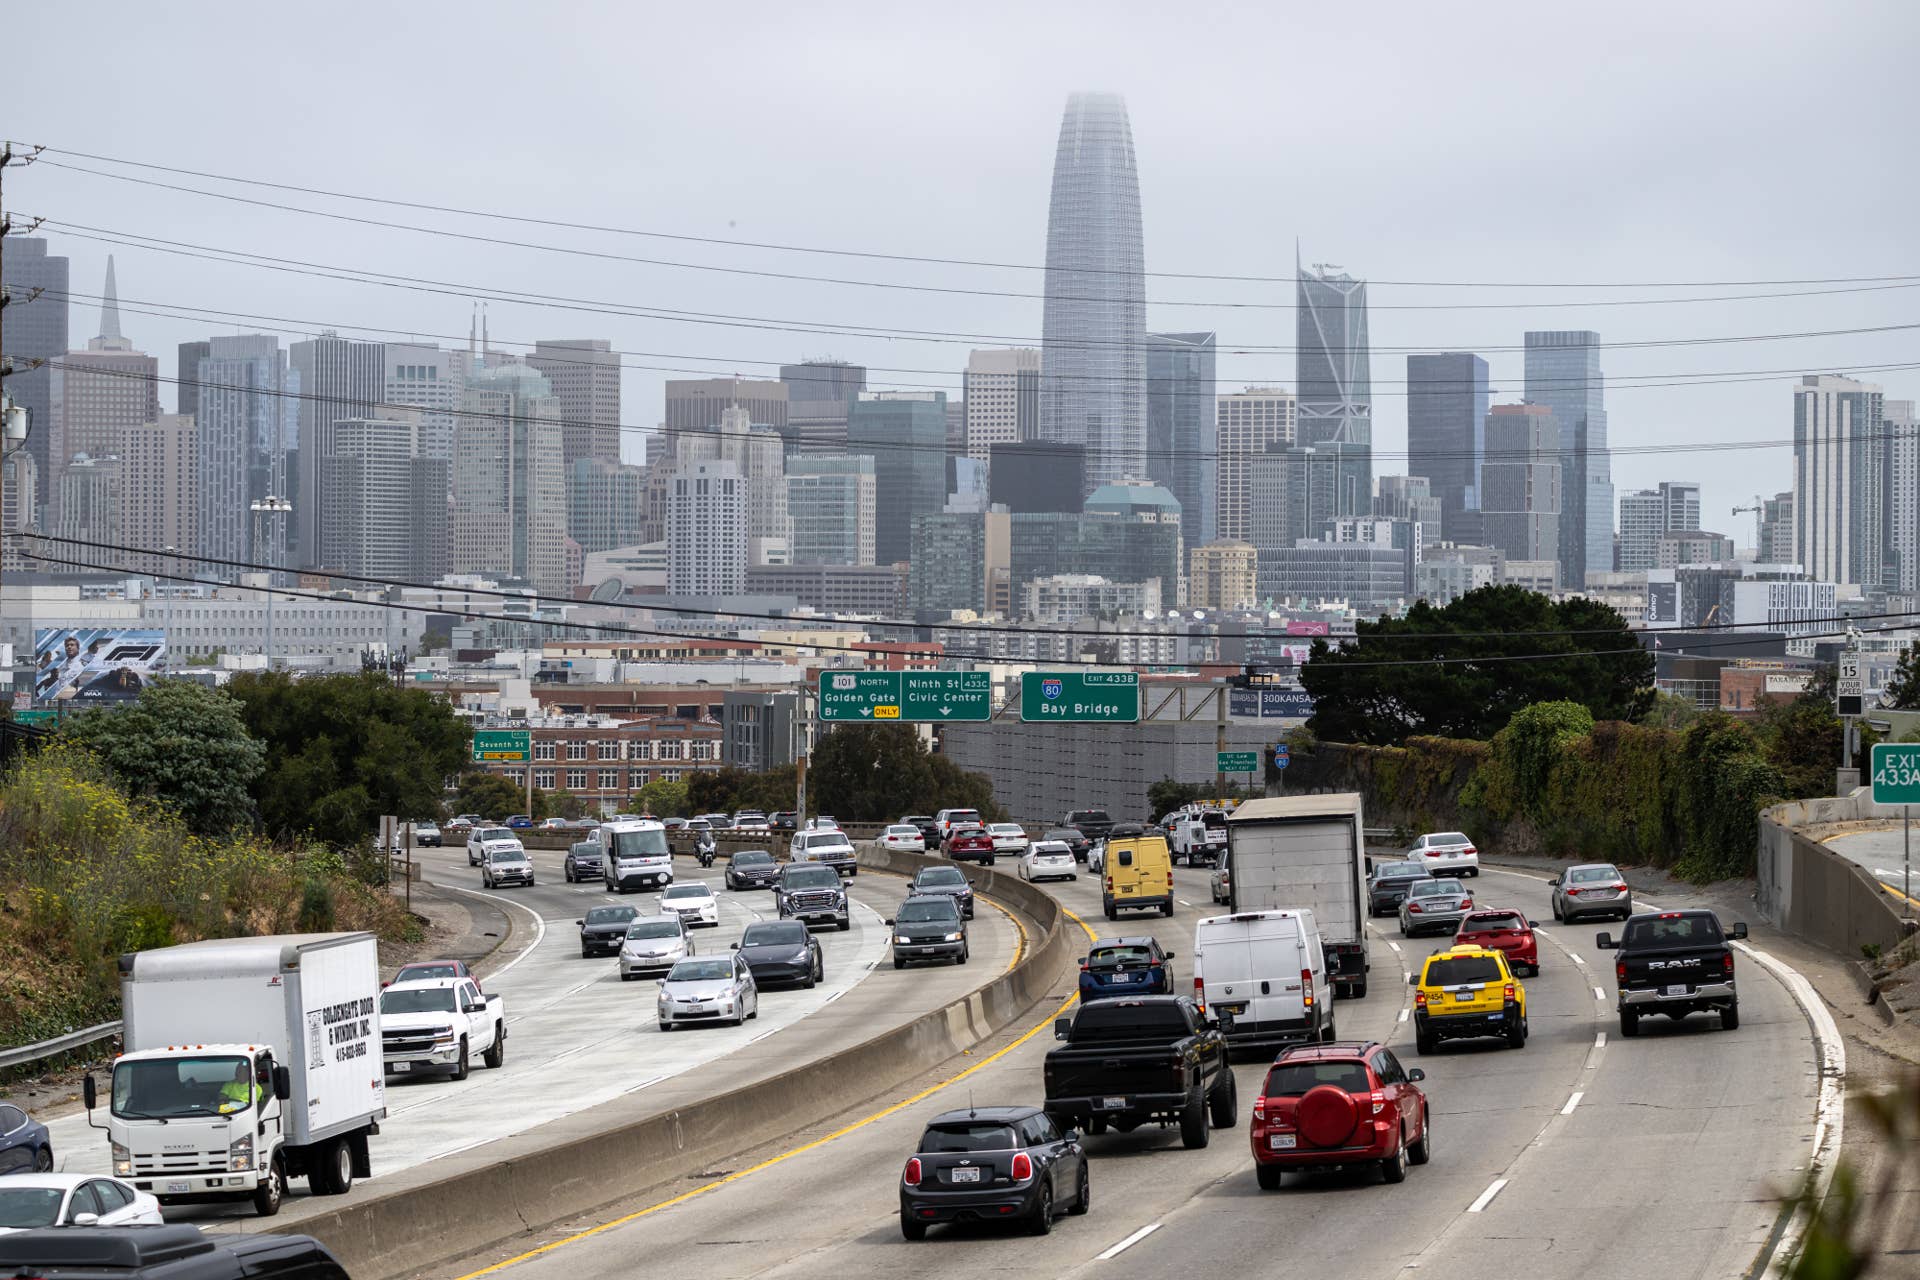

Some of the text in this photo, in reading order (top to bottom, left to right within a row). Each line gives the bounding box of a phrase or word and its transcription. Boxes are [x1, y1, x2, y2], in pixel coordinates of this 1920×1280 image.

[1842, 666, 1857, 677] 15
[838, 679, 851, 687] 101
[1106, 675, 1135, 683] 433B
[909, 680, 959, 689] Ninth St
[1045, 686, 1059, 696] 80
[825, 694, 896, 702] Golden Gate
[909, 693, 982, 702] Civic Center
[825, 708, 838, 716] Br
[875, 707, 898, 716] ONLY
[1041, 703, 1119, 716] Bay Bridge
[1874, 769, 1920, 785] 433A
[1649, 959, 1701, 969] RAM
[323, 997, 374, 1025] GOLDENGATE DOOR
